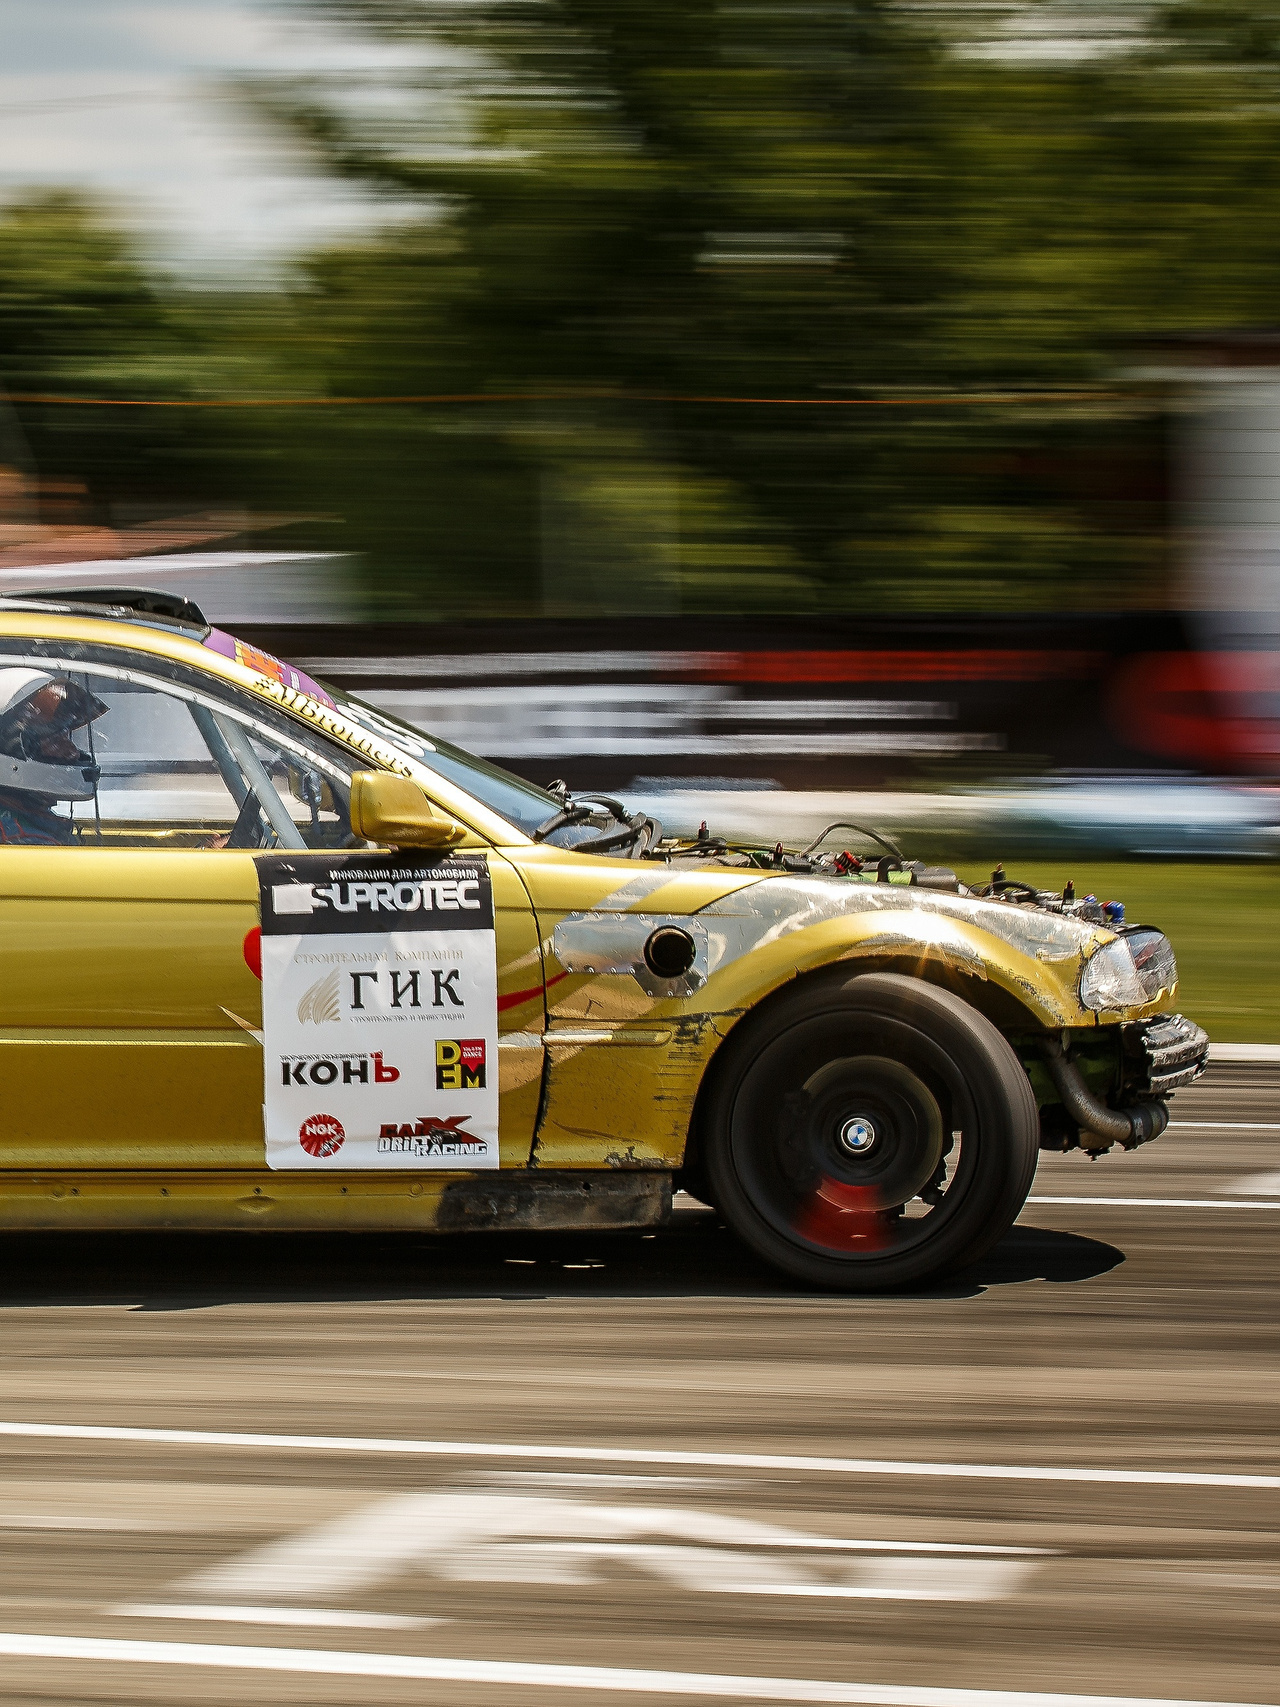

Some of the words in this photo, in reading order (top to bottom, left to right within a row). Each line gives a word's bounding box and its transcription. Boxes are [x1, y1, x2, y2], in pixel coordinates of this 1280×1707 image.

[329, 869, 390, 880] ИННОВАЦИИ
[391, 869, 412, 880] ДЛЯ
[413, 868, 479, 880] АВТОМОБИЛЯ
[312, 880, 480, 913] SUPROTEC
[394, 949, 464, 963] КОМПАНИЯ
[349, 968, 465, 1010] ГИК
[304, 1123, 339, 1137] NGK
[415, 1142, 488, 1158] RACING
